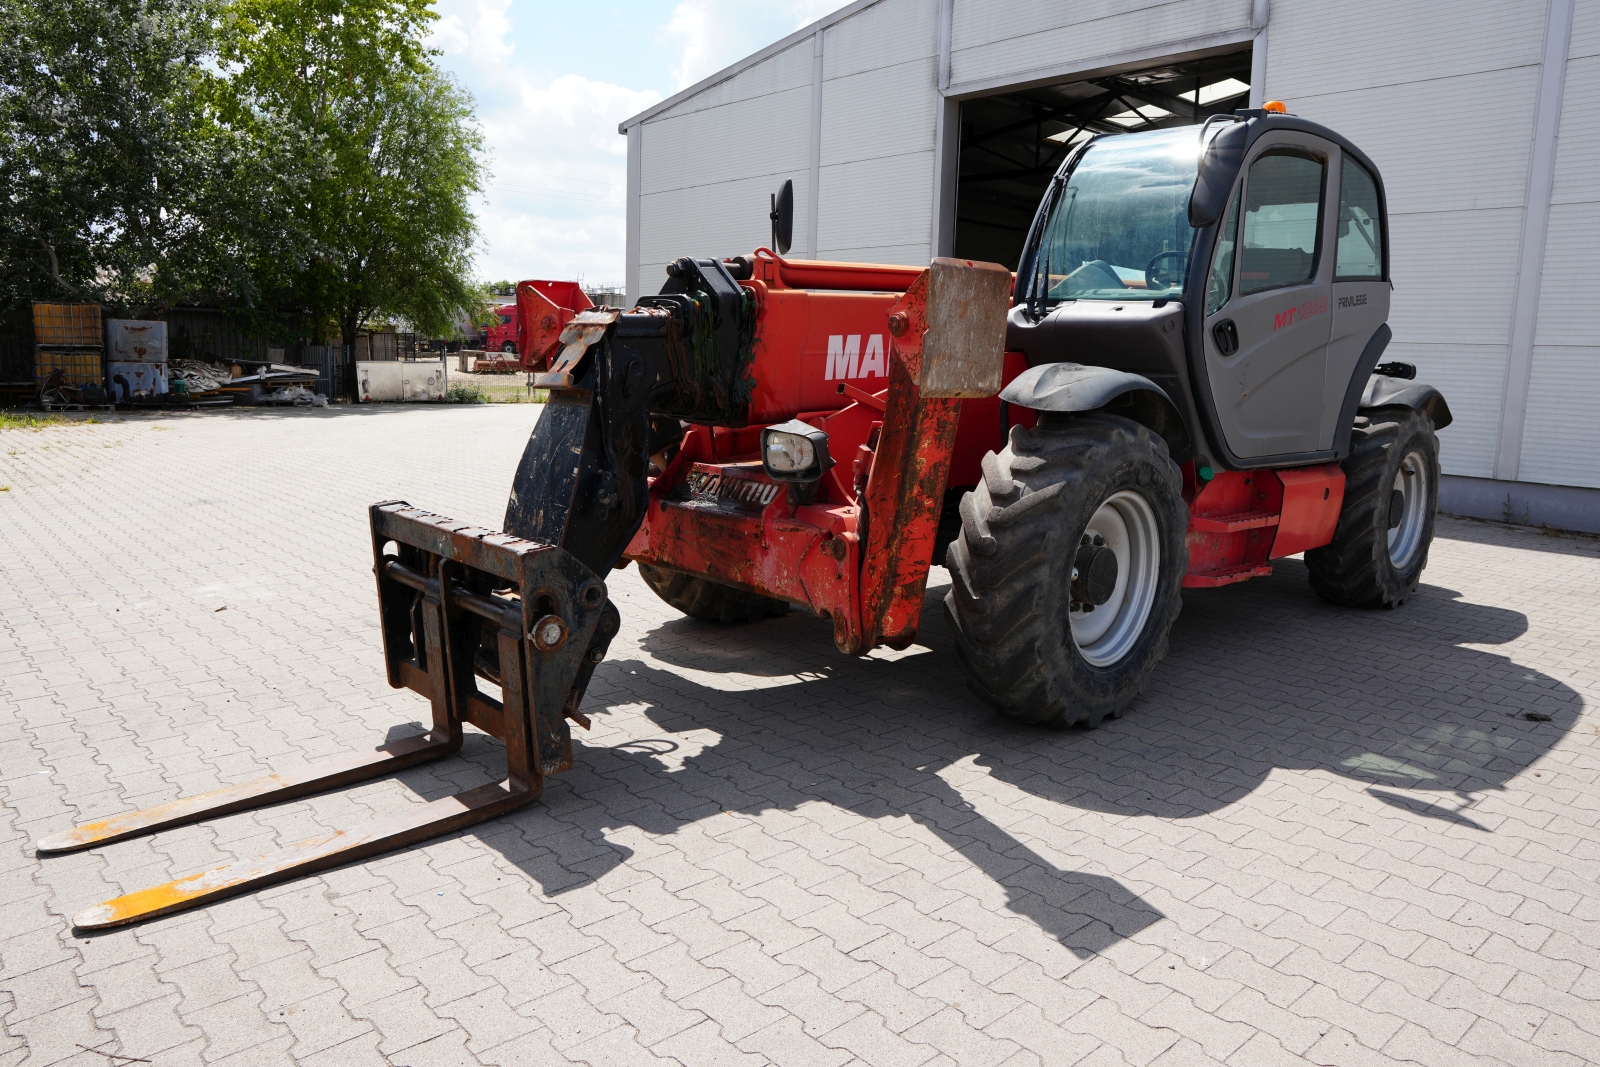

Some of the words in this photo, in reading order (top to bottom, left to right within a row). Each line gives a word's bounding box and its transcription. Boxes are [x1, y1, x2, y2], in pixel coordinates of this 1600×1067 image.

[1273, 307, 1297, 331] MT
[1298, 296, 1328, 321] 1840
[1338, 294, 1367, 309] PRIVILEGE
[824, 334, 891, 380] MA
